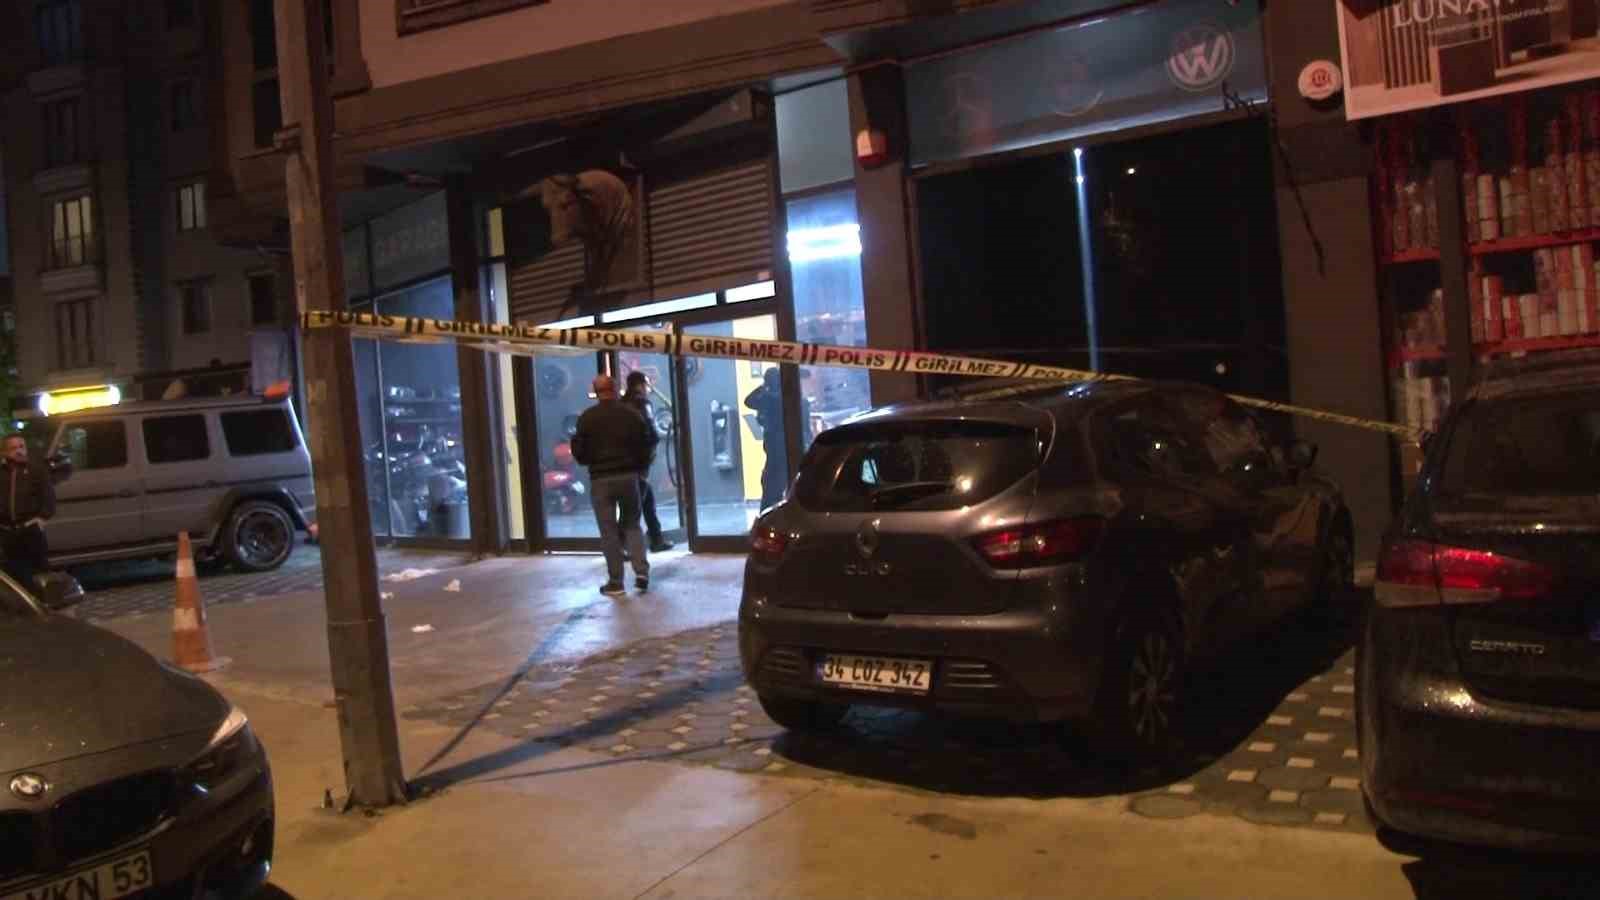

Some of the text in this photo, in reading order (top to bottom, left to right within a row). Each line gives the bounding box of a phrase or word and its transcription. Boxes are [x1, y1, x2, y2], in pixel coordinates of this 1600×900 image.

[1393, 0, 1518, 28] LUNA
[823, 658, 844, 679] 34
[891, 661, 924, 686] 342
[113, 855, 148, 892] 53
